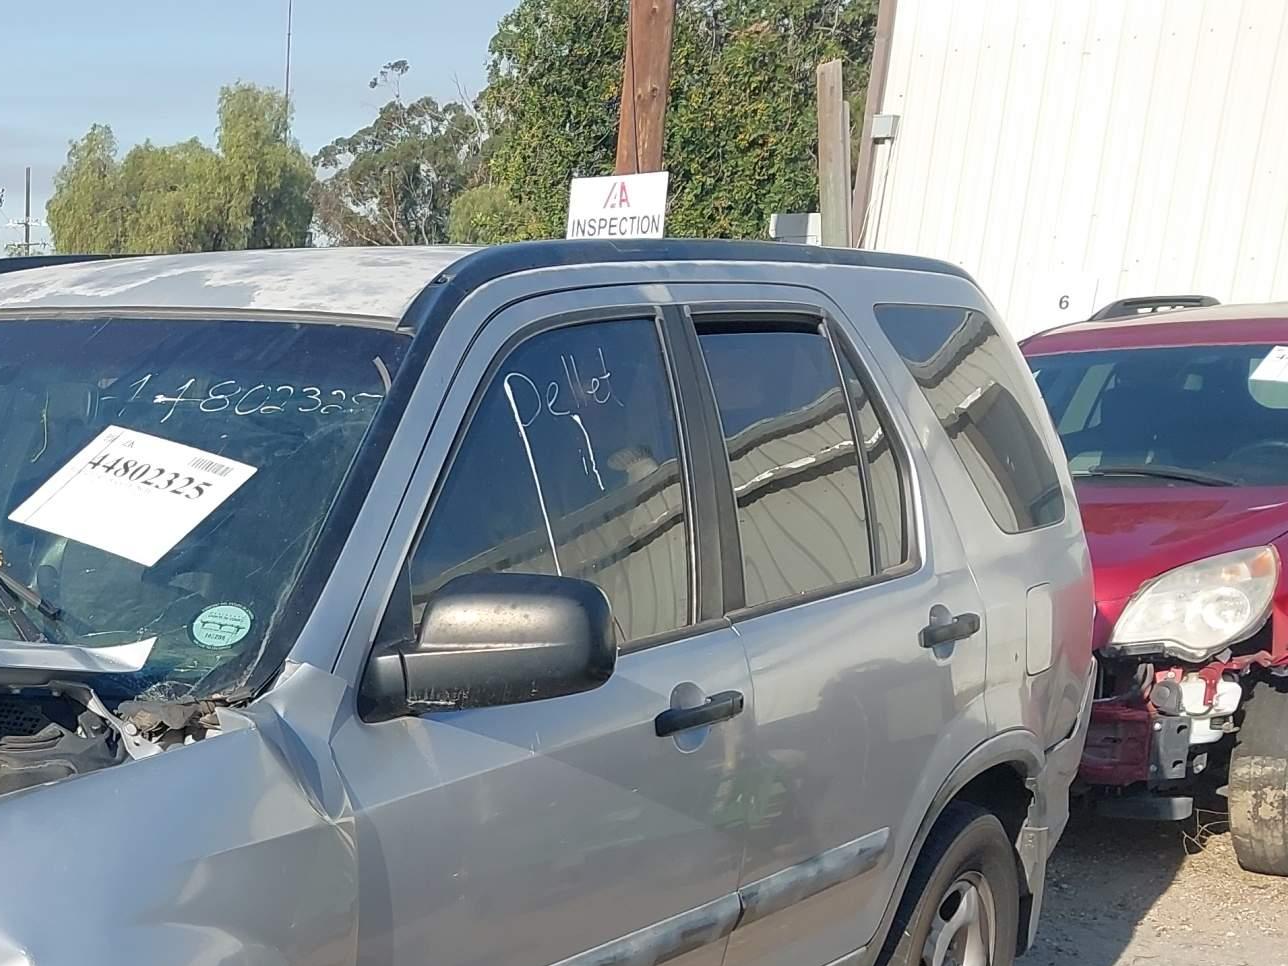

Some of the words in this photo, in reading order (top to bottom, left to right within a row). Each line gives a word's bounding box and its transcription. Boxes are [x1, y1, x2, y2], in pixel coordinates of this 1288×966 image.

[571, 214, 661, 238] INSPECTION
[1059, 295, 1069, 310] 6
[88, 453, 213, 500] 44802325
